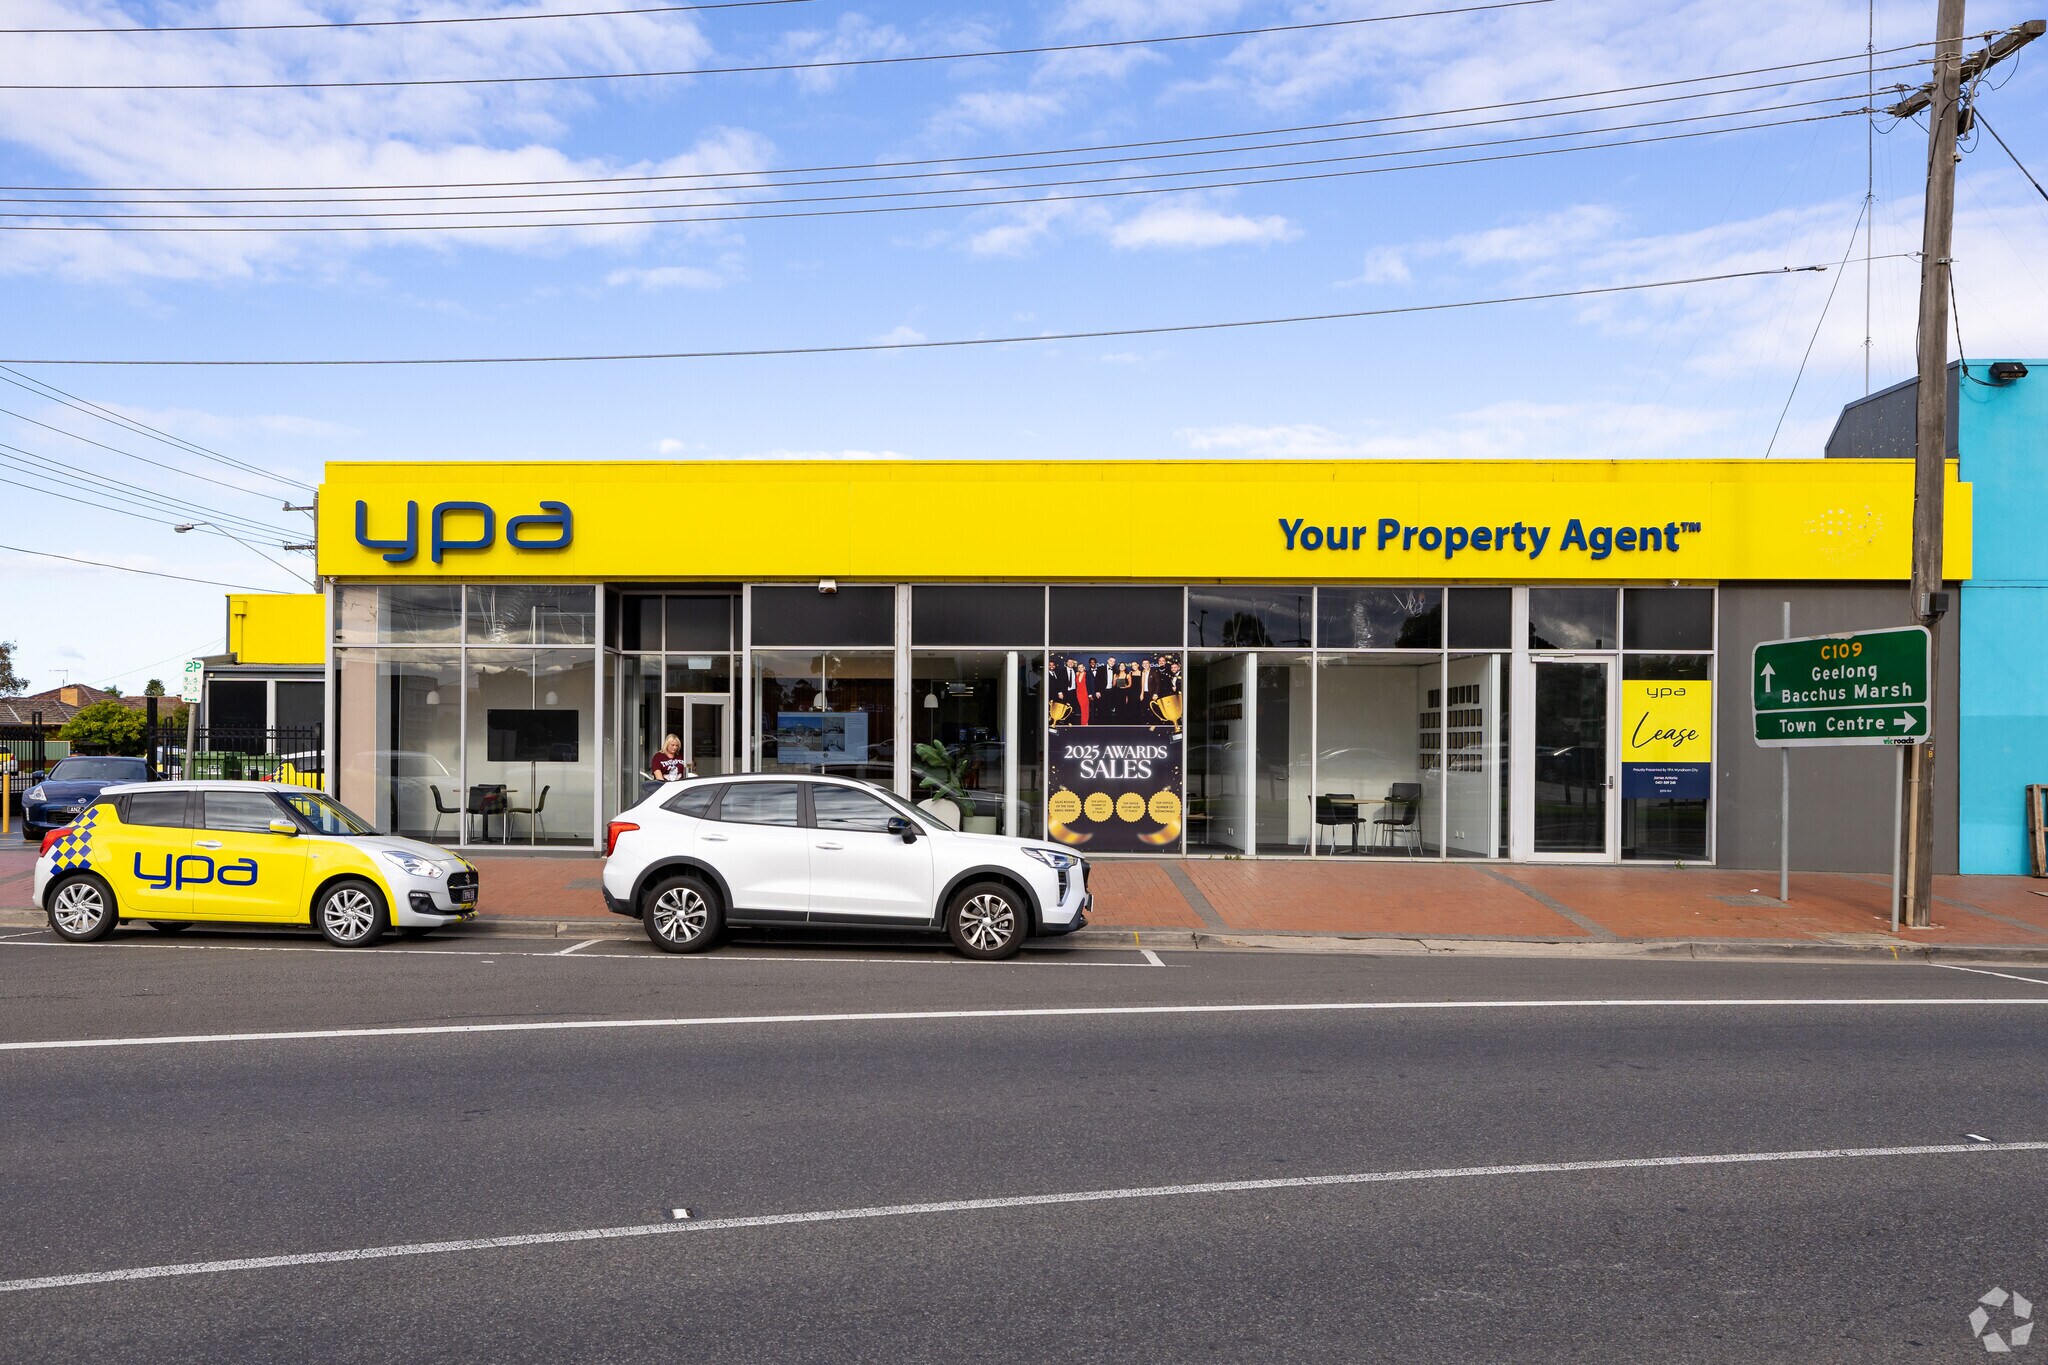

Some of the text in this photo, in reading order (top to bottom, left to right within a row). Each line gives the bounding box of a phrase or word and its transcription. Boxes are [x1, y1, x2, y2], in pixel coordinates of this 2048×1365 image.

[355, 500, 573, 563] ypa
[1279, 518, 1367, 551] Your
[1378, 518, 1551, 560] Property
[1821, 642, 1863, 660] C109
[185, 661, 202, 673] 2P
[1812, 665, 1878, 682] Geelong
[1646, 687, 1686, 699] ypa
[1782, 682, 1912, 704] Bacchus Marsh
[1632, 711, 1700, 749] Lease
[1780, 716, 1885, 733] Town Centre
[1064, 745, 1168, 761] 2025 AWARDS
[1080, 759, 1152, 779] SALES
[134, 851, 258, 891] ypa
